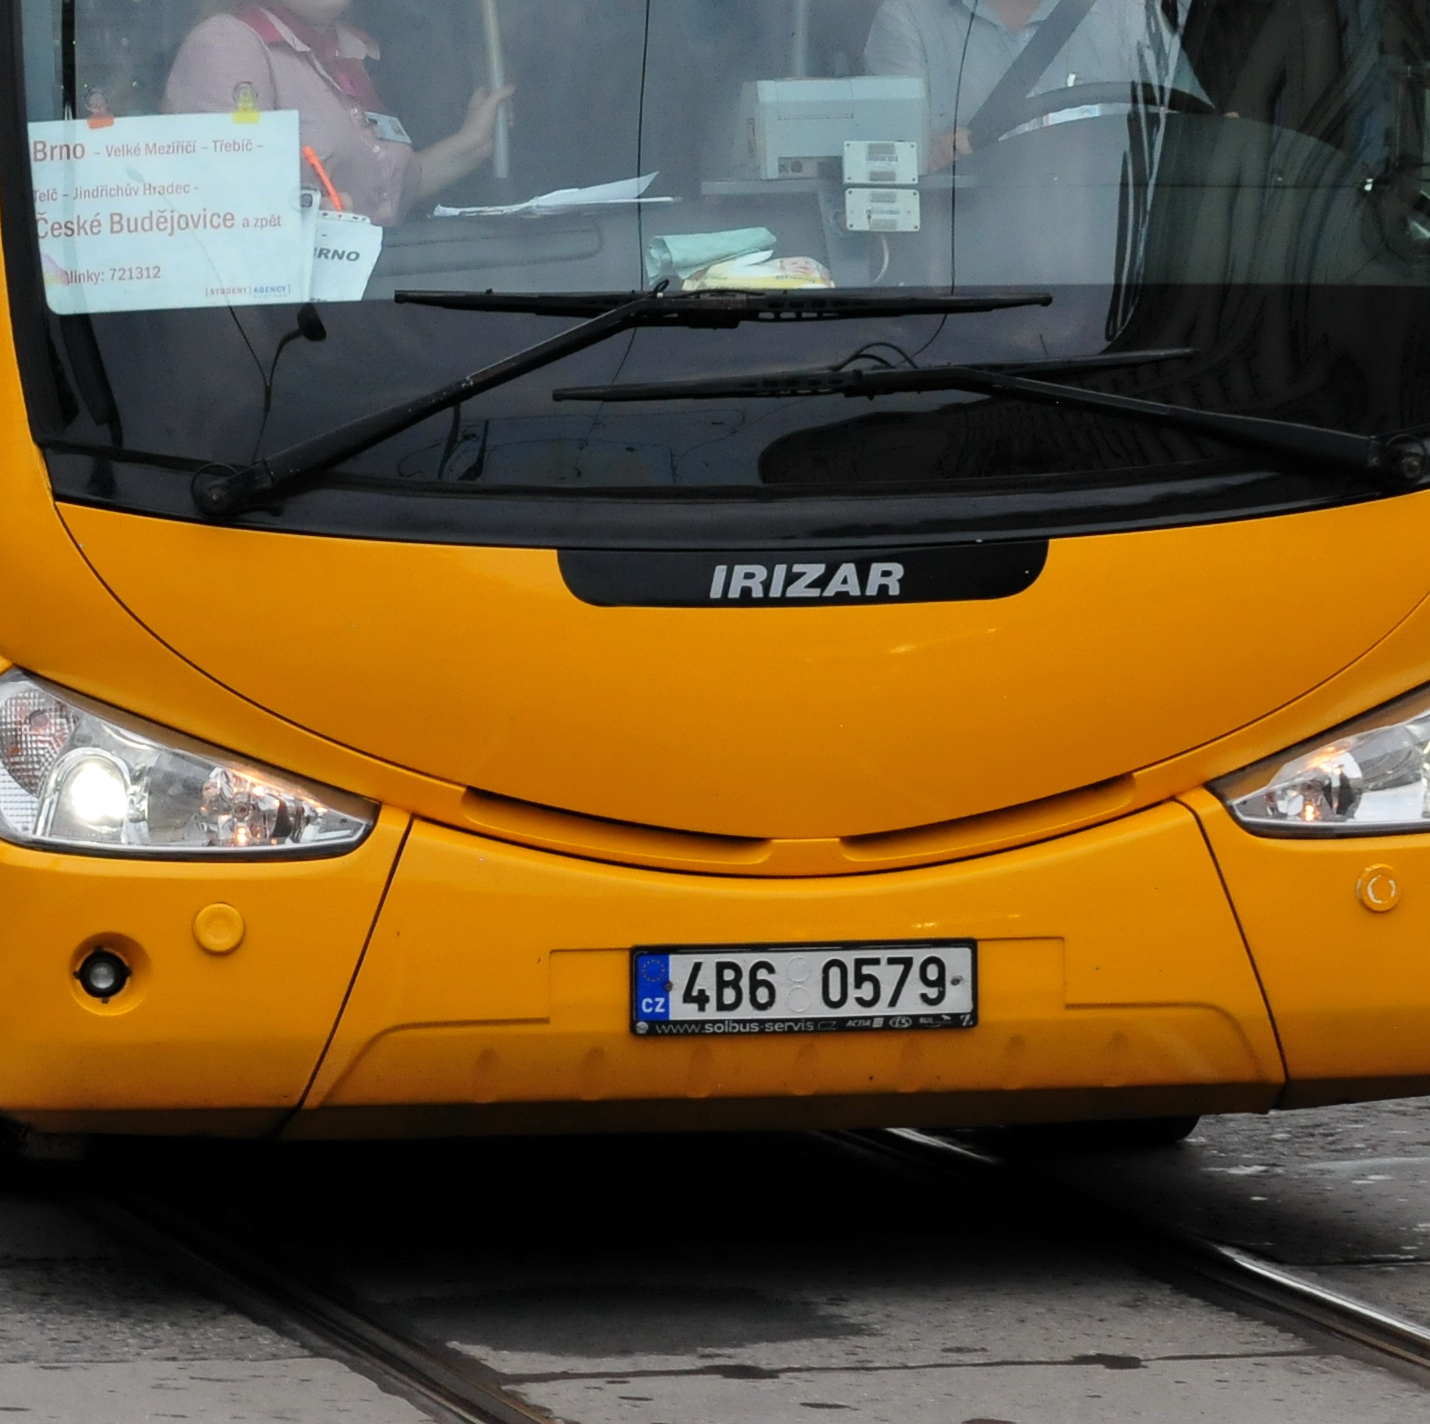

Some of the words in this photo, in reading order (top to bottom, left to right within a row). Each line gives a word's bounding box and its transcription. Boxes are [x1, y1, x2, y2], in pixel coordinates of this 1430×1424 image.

[32, 140, 85, 163] Brno
[105, 142, 141, 158] Velké
[144, 140, 196, 157] Meziříčí
[211, 138, 254, 154] Třebíč
[33, 187, 58, 203] Telč
[72, 183, 139, 200] Jindřichův
[143, 182, 191, 197] Hradec
[36, 211, 102, 239] České
[109, 207, 236, 236] Budějovice
[242, 217, 250, 228] a
[253, 213, 282, 229] zpět
[109, 265, 161, 281] 721312
[209, 287, 247, 296] STUDENT
[253, 285, 286, 295] AGENCY
[709, 561, 905, 599] IRIZAR
[682, 959, 777, 1012] 4B6
[821, 955, 947, 1009] 0579
[641, 997, 666, 1013] CZ
